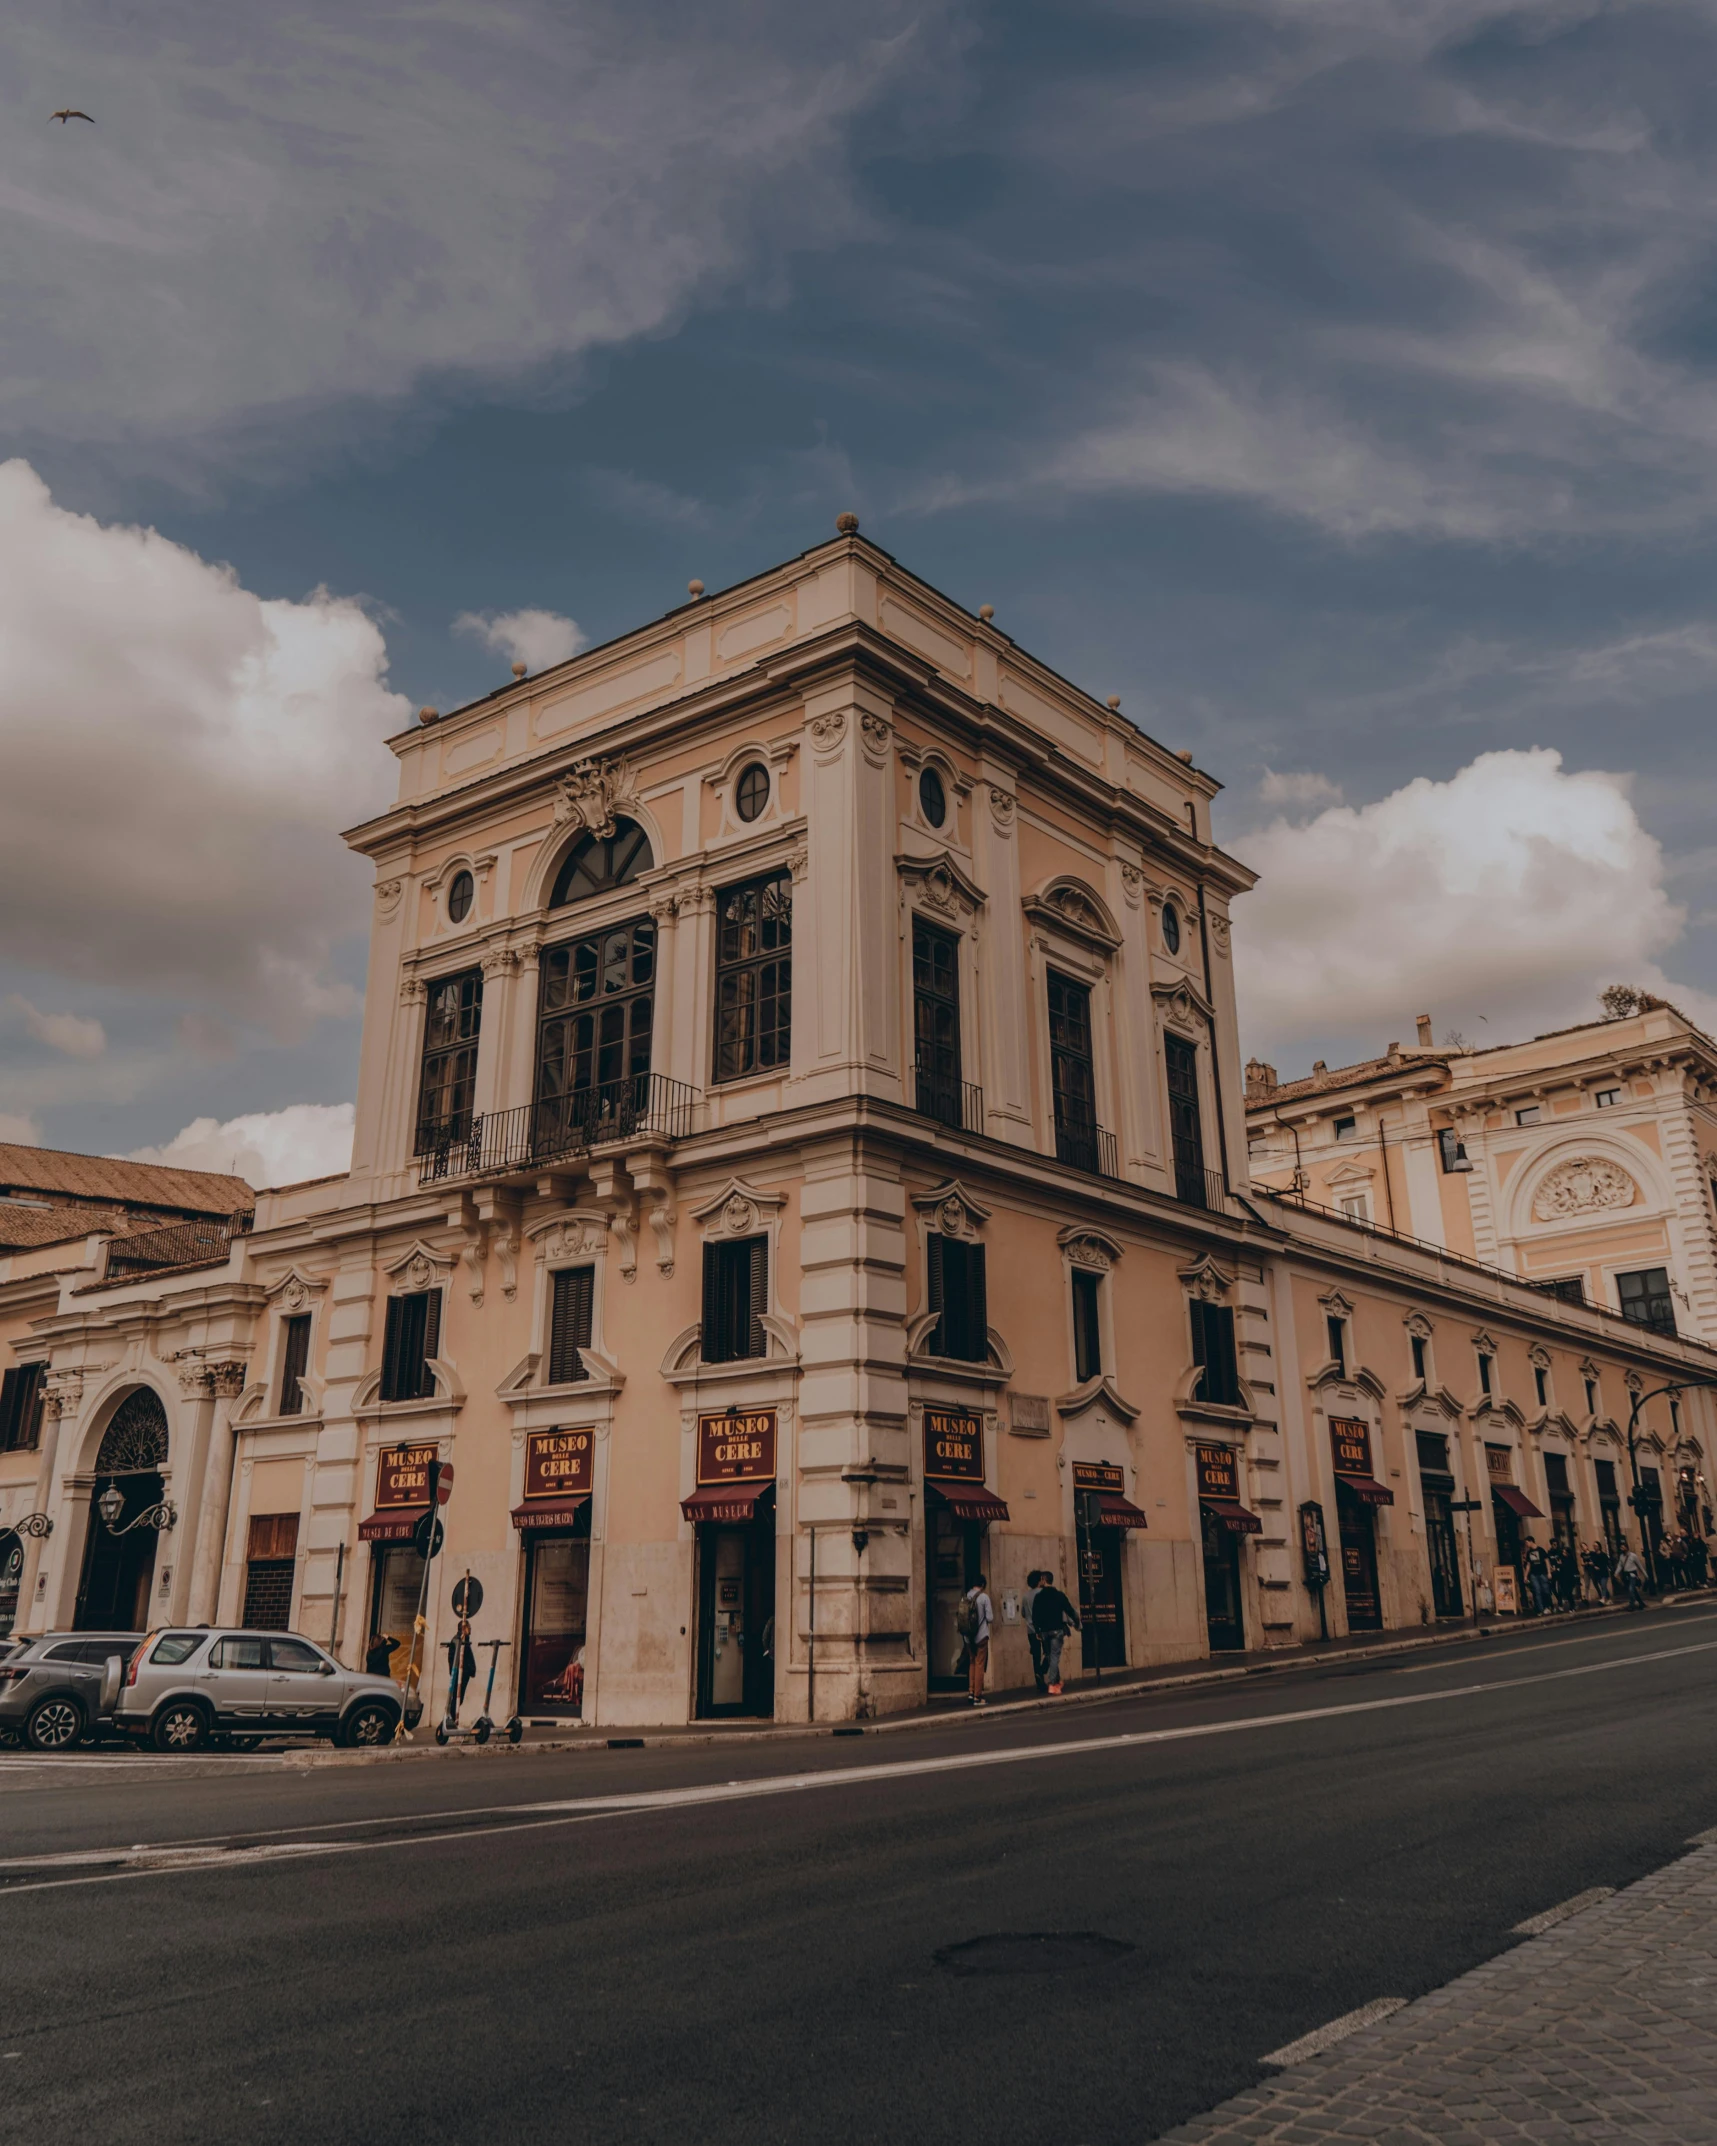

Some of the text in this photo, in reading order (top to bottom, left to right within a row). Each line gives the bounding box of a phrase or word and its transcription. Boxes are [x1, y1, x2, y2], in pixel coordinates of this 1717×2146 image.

[709, 1416, 769, 1437] MUSEO
[930, 1416, 977, 1435] MUSEO
[1335, 1422, 1365, 1439] MUSEO
[535, 1435, 588, 1454] MUSEO
[728, 1435, 748, 1443] DELLE
[387, 1450, 433, 1467] MUSEO
[715, 1442, 762, 1461] CERE
[936, 1441, 972, 1460] CERE
[1200, 1449, 1232, 1465] MUSEO
[1340, 1444, 1364, 1460] CERE
[540, 1459, 580, 1477] CERE
[1076, 1468, 1097, 1478] MUSEO
[1104, 1471, 1120, 1480] CERE
[390, 1472, 426, 1488] CERE
[1205, 1470, 1230, 1485] CERE
[713, 1505, 749, 1518] MUSEUM
[384, 1526, 392, 1538] DE
[6, 1577, 17, 1586] Club
